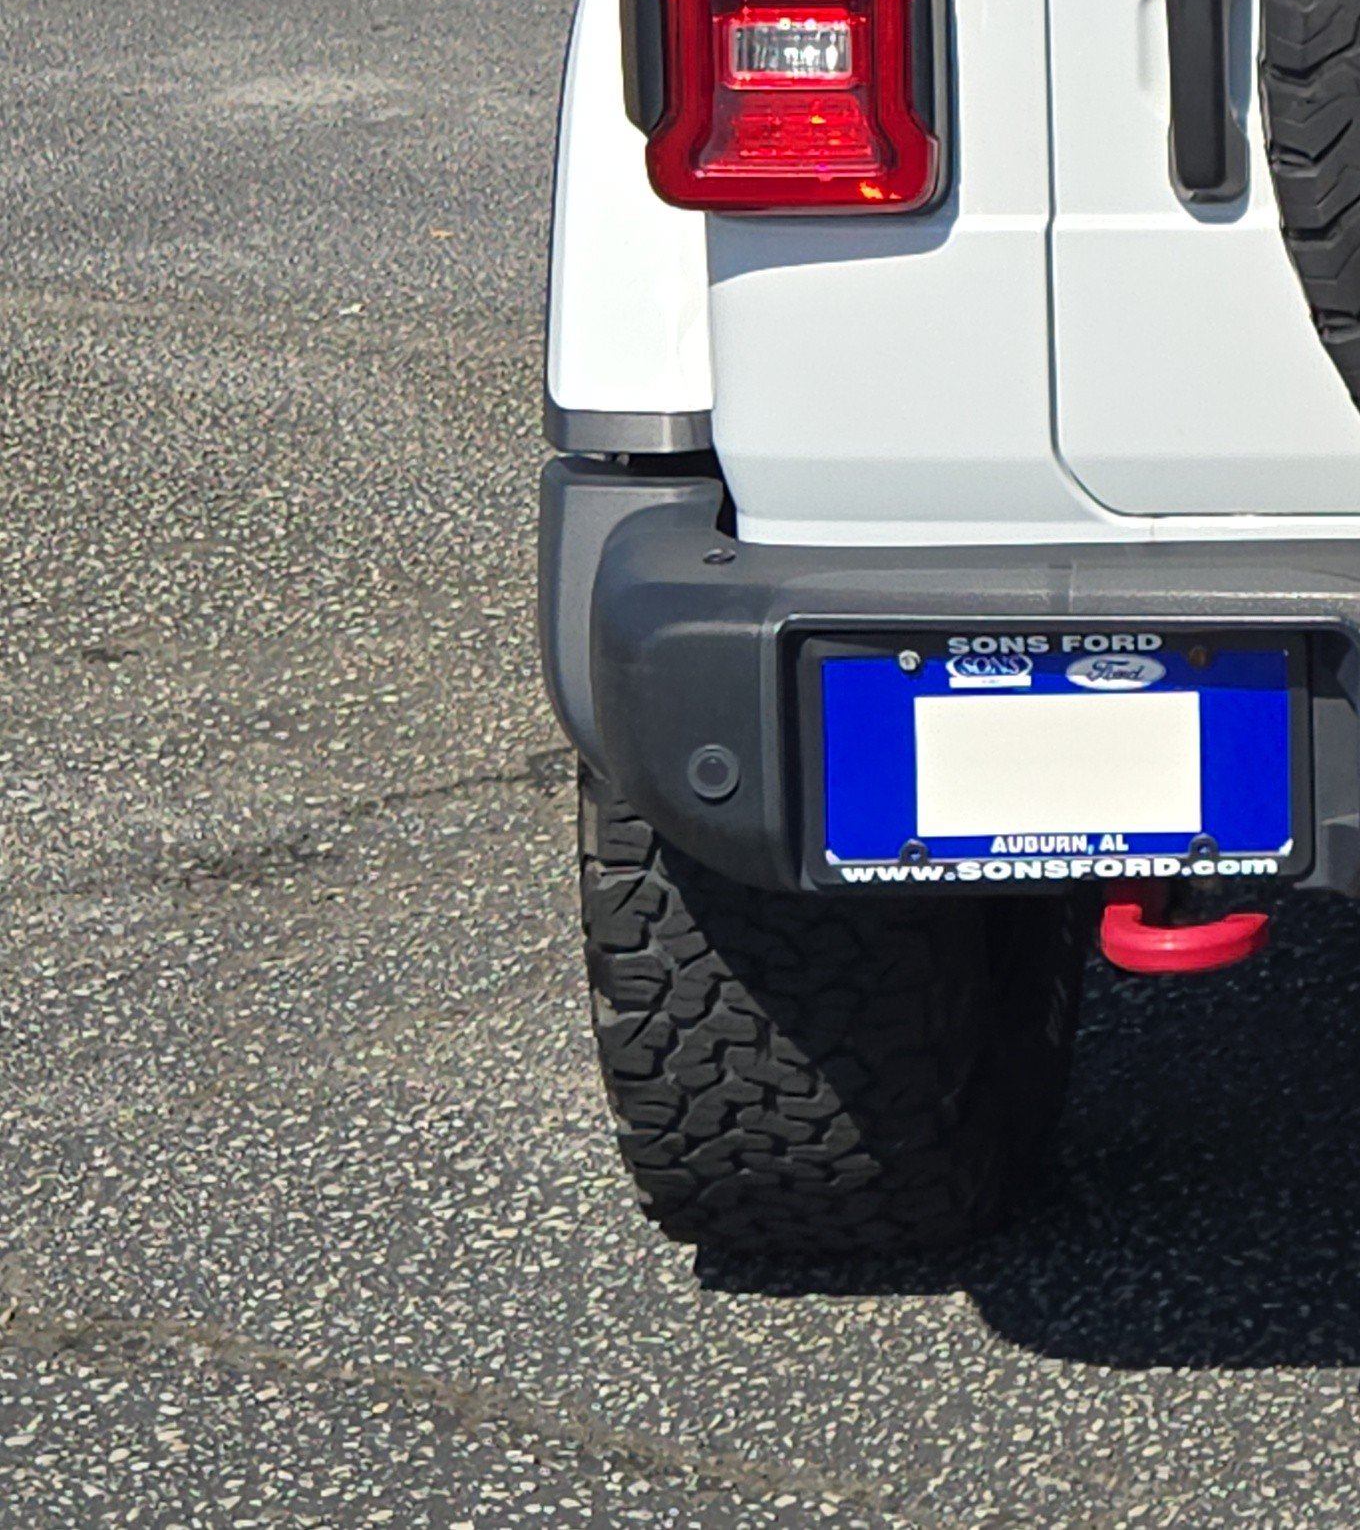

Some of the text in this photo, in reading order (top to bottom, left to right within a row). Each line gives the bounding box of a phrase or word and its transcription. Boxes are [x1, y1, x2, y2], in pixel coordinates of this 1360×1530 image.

[947, 634, 1163, 654] SONS FORD
[1100, 834, 1129, 852] AL
[841, 857, 1279, 882] www.SONSFORD.com
